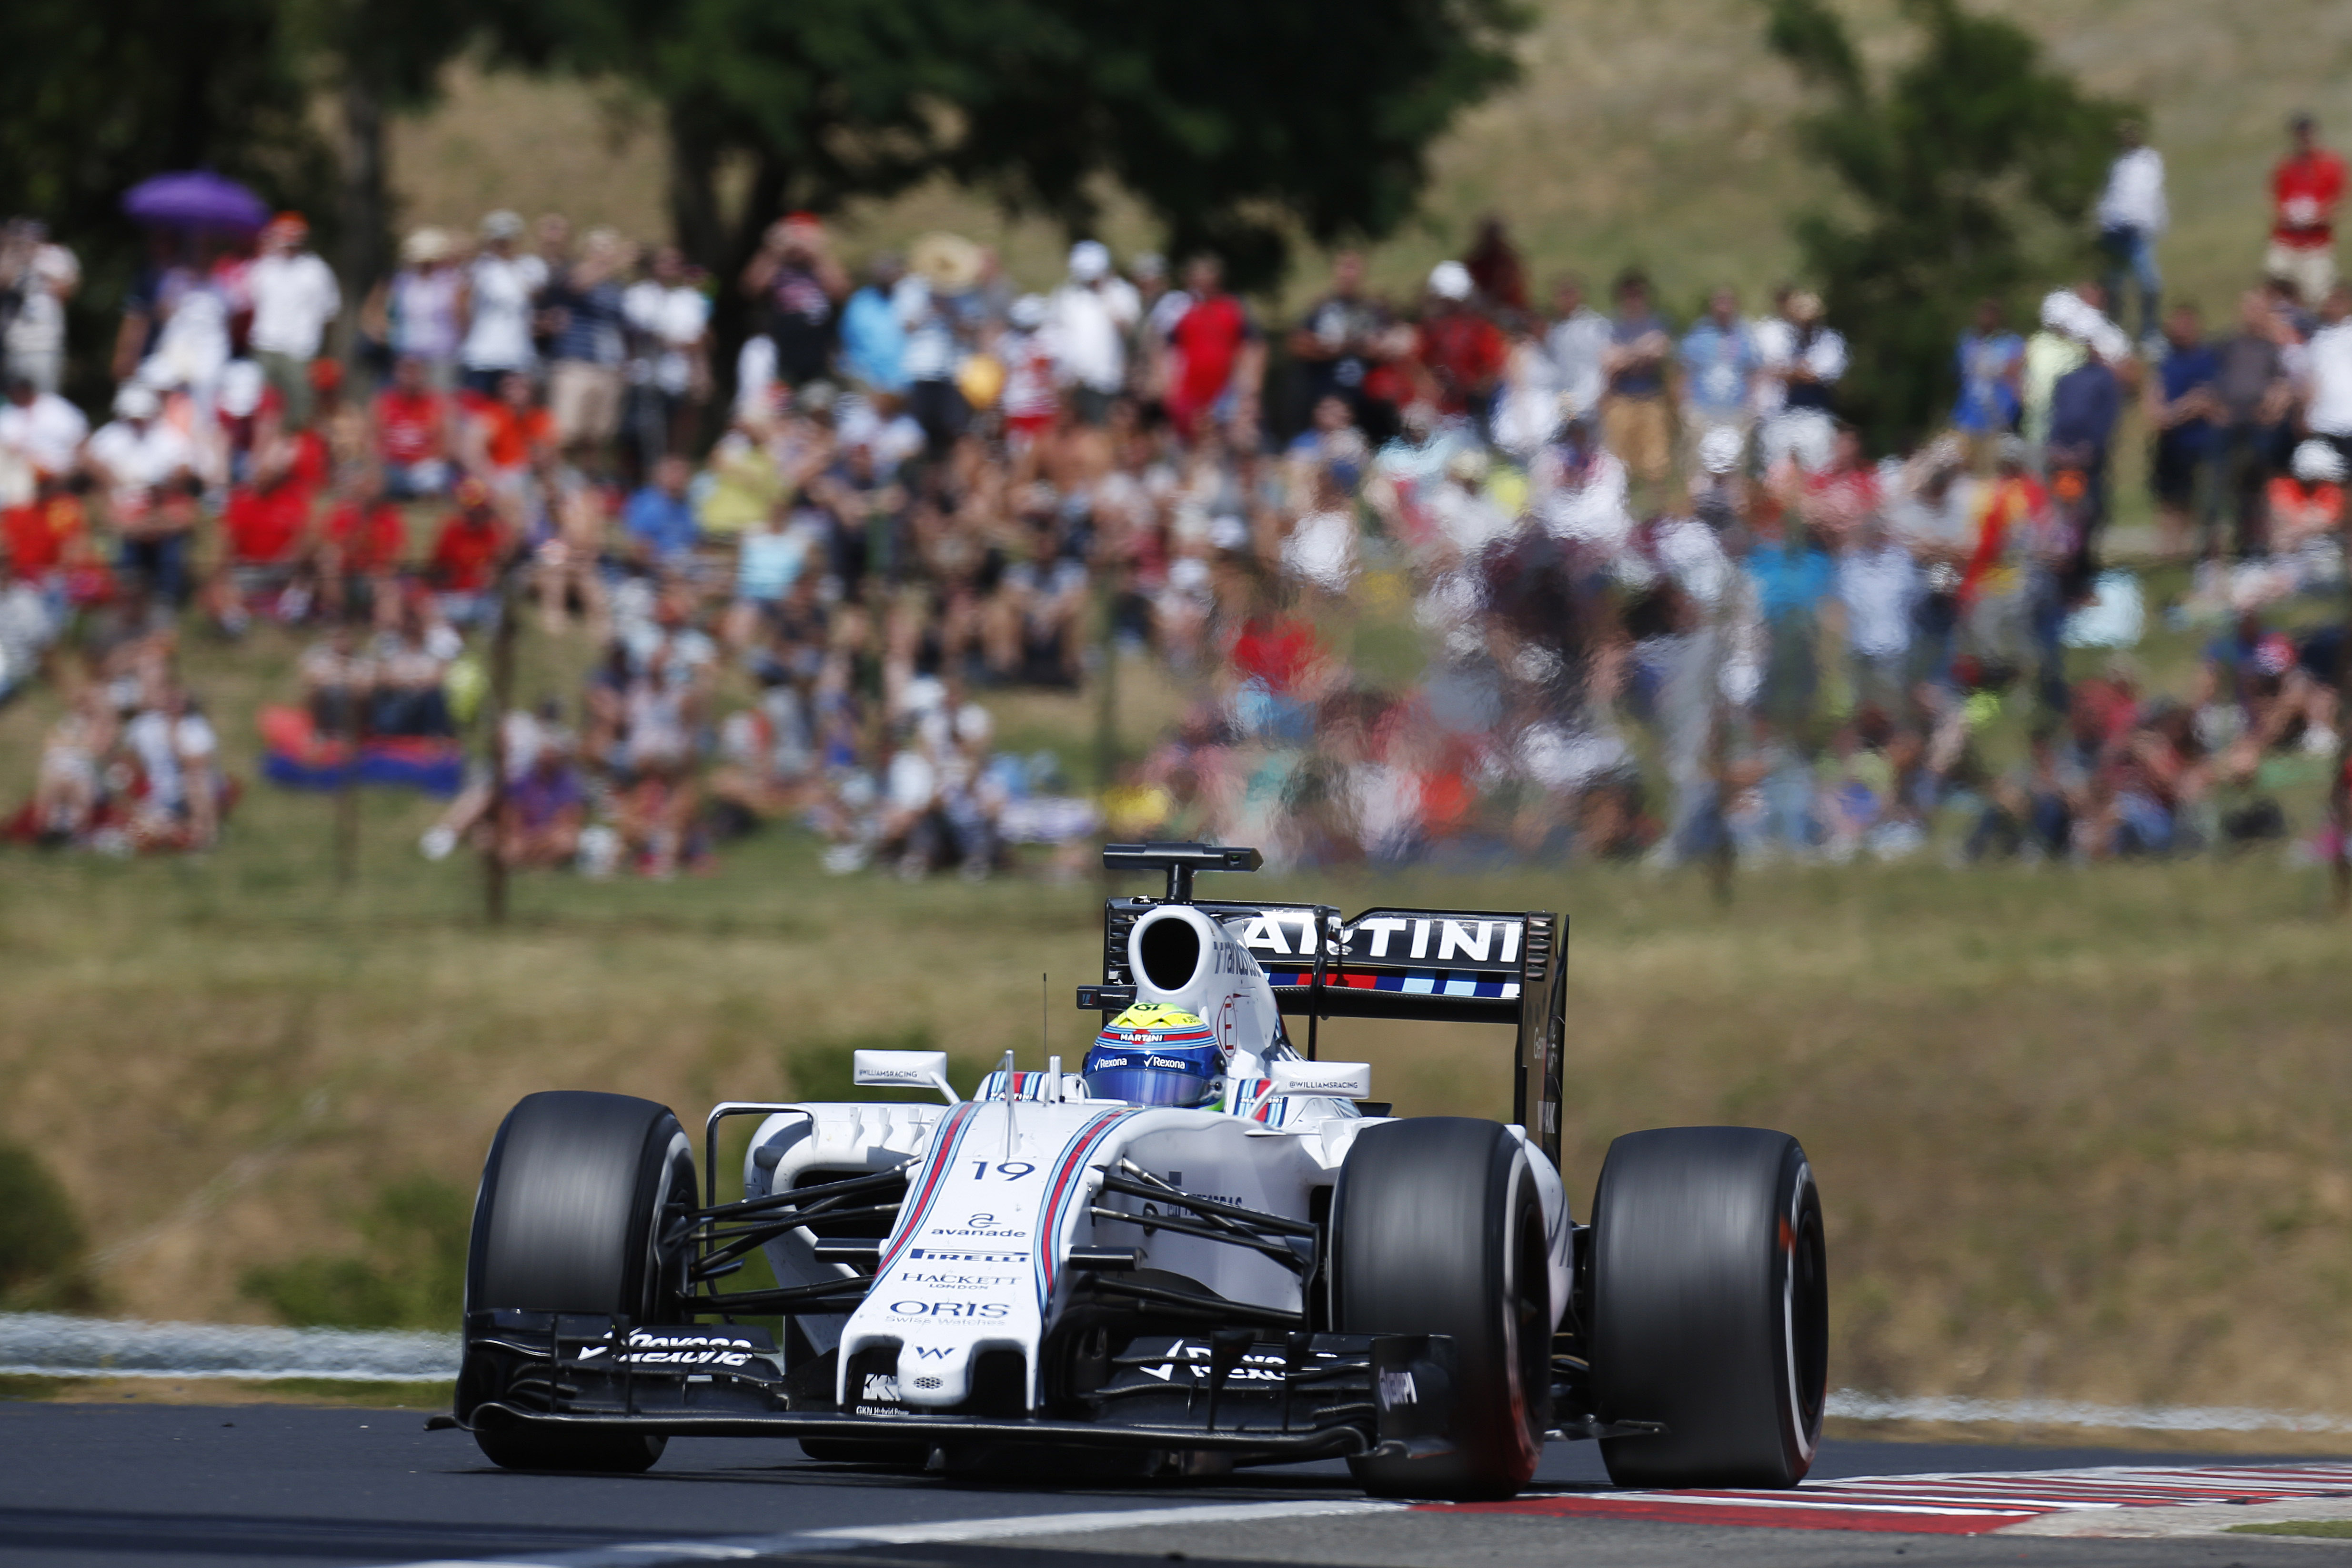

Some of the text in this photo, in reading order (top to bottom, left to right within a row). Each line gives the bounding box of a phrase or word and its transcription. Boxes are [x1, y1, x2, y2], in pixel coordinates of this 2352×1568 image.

[1120, 1034, 1163, 1042] MARTINI
[1100, 1057, 1127, 1068] Rexona
[1153, 1056, 1186, 1069] Rexona
[991, 1092, 1033, 1100] MATINI
[972, 1160, 1035, 1181] 19
[931, 1228, 1026, 1237] avanade
[909, 1248, 1031, 1262] PIRELLI
[900, 1273, 1022, 1285] HACKETT
[890, 1300, 1011, 1318] ORIS
[885, 1315, 1006, 1326] Swiss Watches
[856, 1406, 873, 1416] GKN
[874, 1407, 894, 1416] Hybrid
